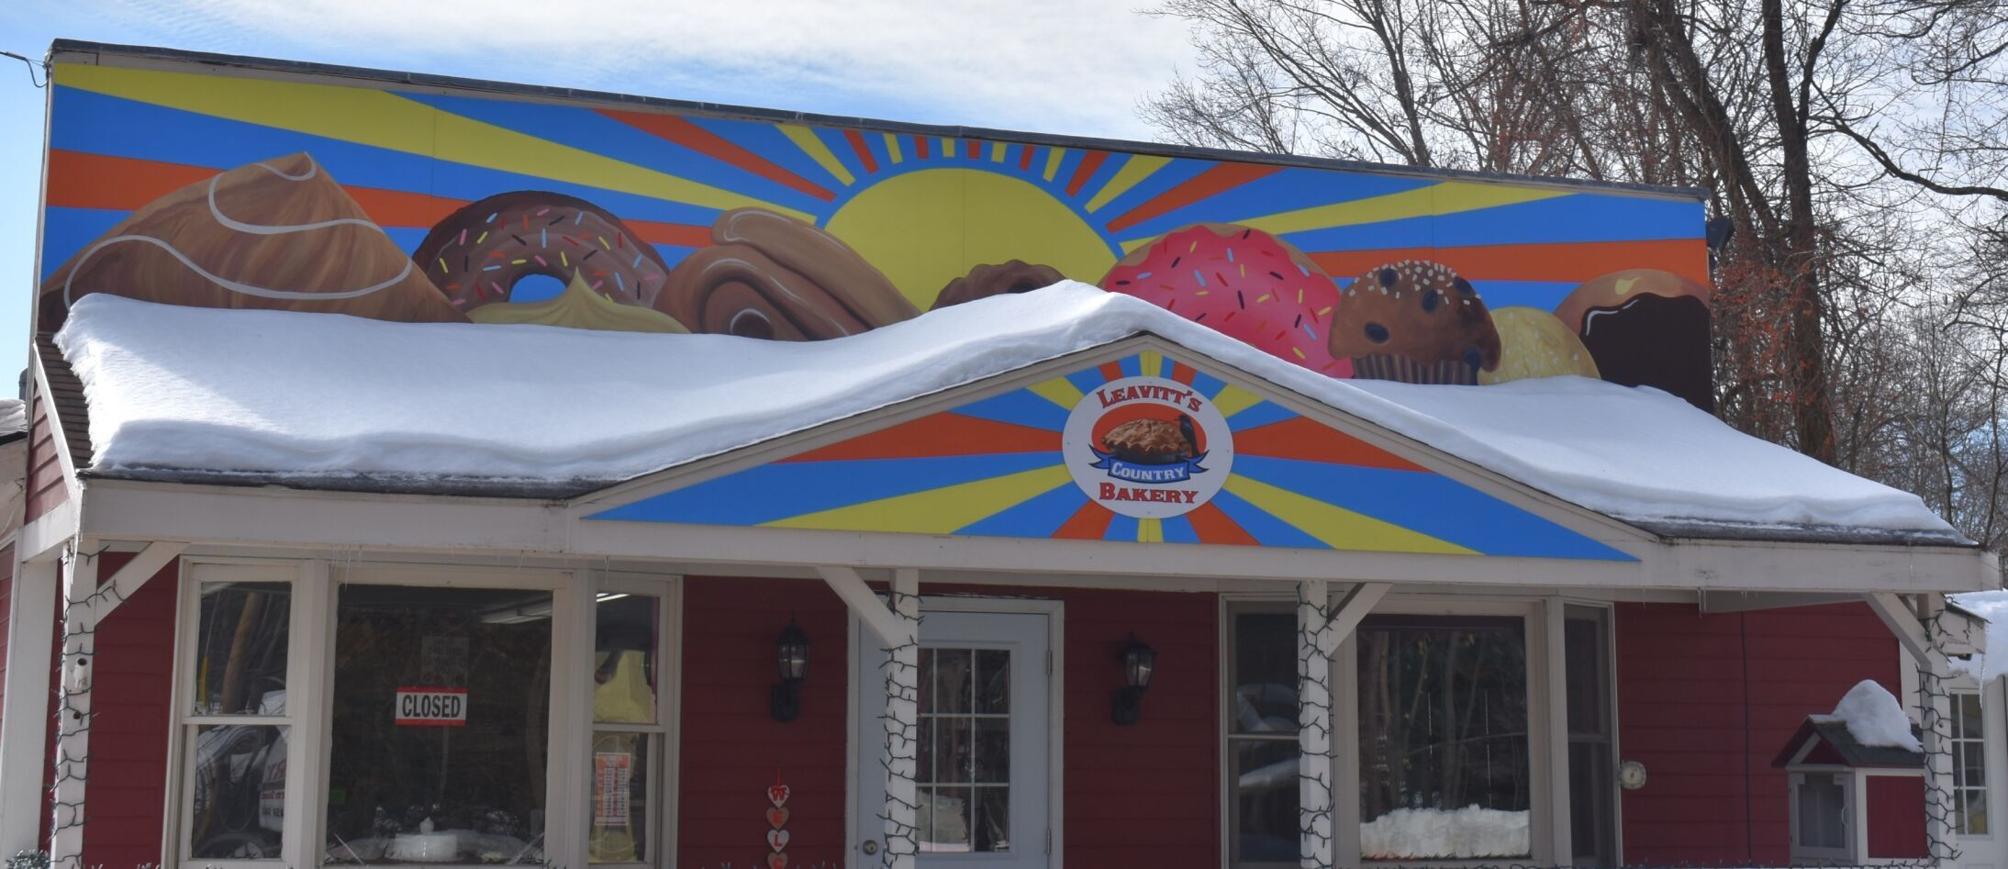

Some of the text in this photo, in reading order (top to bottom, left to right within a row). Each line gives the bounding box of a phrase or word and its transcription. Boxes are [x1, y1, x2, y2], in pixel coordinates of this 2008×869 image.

[1096, 385, 1202, 412] LEAVITT'S
[1111, 462, 1185, 481] COUNTRY
[1099, 482, 1199, 504] BAKERY
[402, 694, 461, 718] CLOSED
